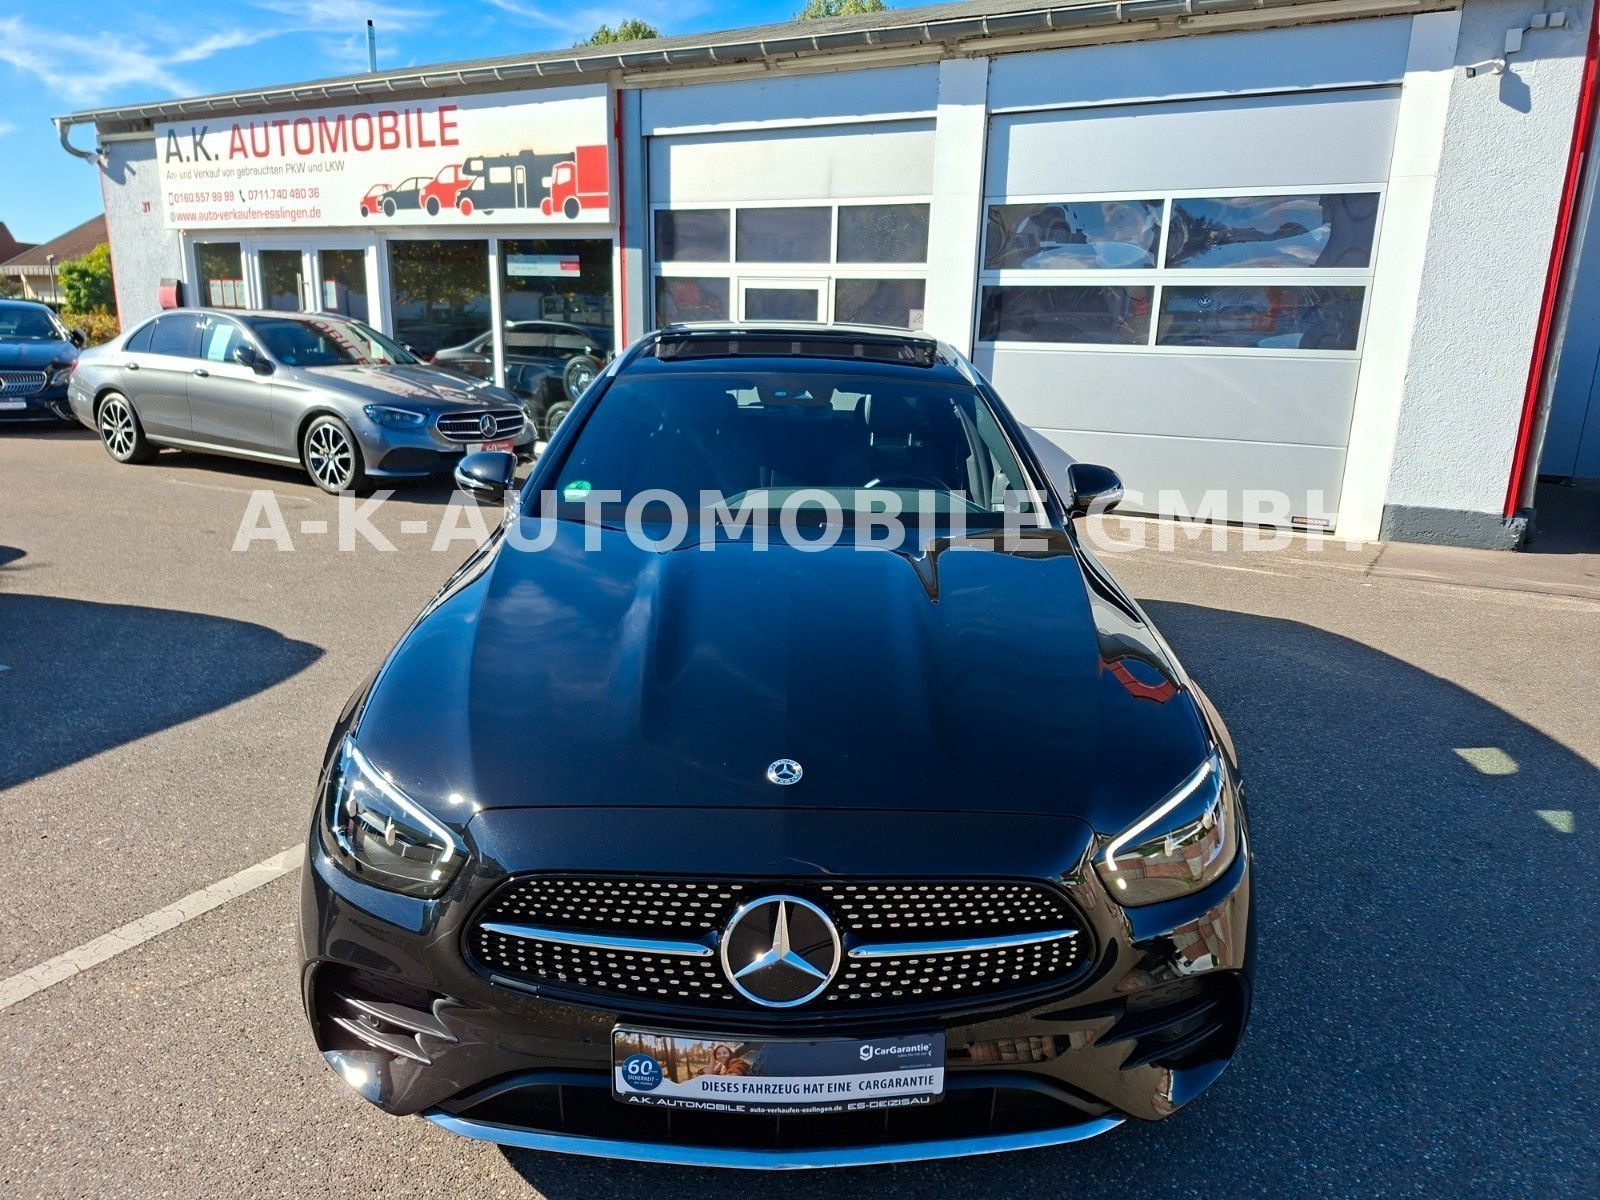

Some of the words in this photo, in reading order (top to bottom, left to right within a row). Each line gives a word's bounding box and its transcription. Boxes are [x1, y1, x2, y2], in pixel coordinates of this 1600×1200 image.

[165, 125, 219, 164] A.K.
[229, 104, 460, 161] AUTOMOBILE
[179, 169, 192, 180] und
[194, 166, 221, 179] Verkauf
[222, 167, 235, 178] von
[236, 165, 284, 180] gebrauchten
[285, 162, 306, 174] PKW
[308, 161, 323, 173] und
[325, 160, 345, 172] LKW
[308, 187, 320, 199] 36
[176, 206, 322, 223] www.auto-verkaufen-esslingen.de
[874, 1043, 930, 1056] CarGarantie
[627, 1059, 653, 1076] 60
[701, 1080, 739, 1094] DIESES
[742, 1082, 800, 1095] FAHRZEUG
[803, 1082, 825, 1095] HAT
[827, 1081, 852, 1094] EINE
[858, 1075, 935, 1091] CARGARANTIE
[628, 1095, 655, 1105] A.K.
[657, 1098, 746, 1112] AUTOMOBILE
[749, 1105, 843, 1114] auto-verkaufen-esslingen.de
[847, 1096, 931, 1111] ES-DEIZISAU
